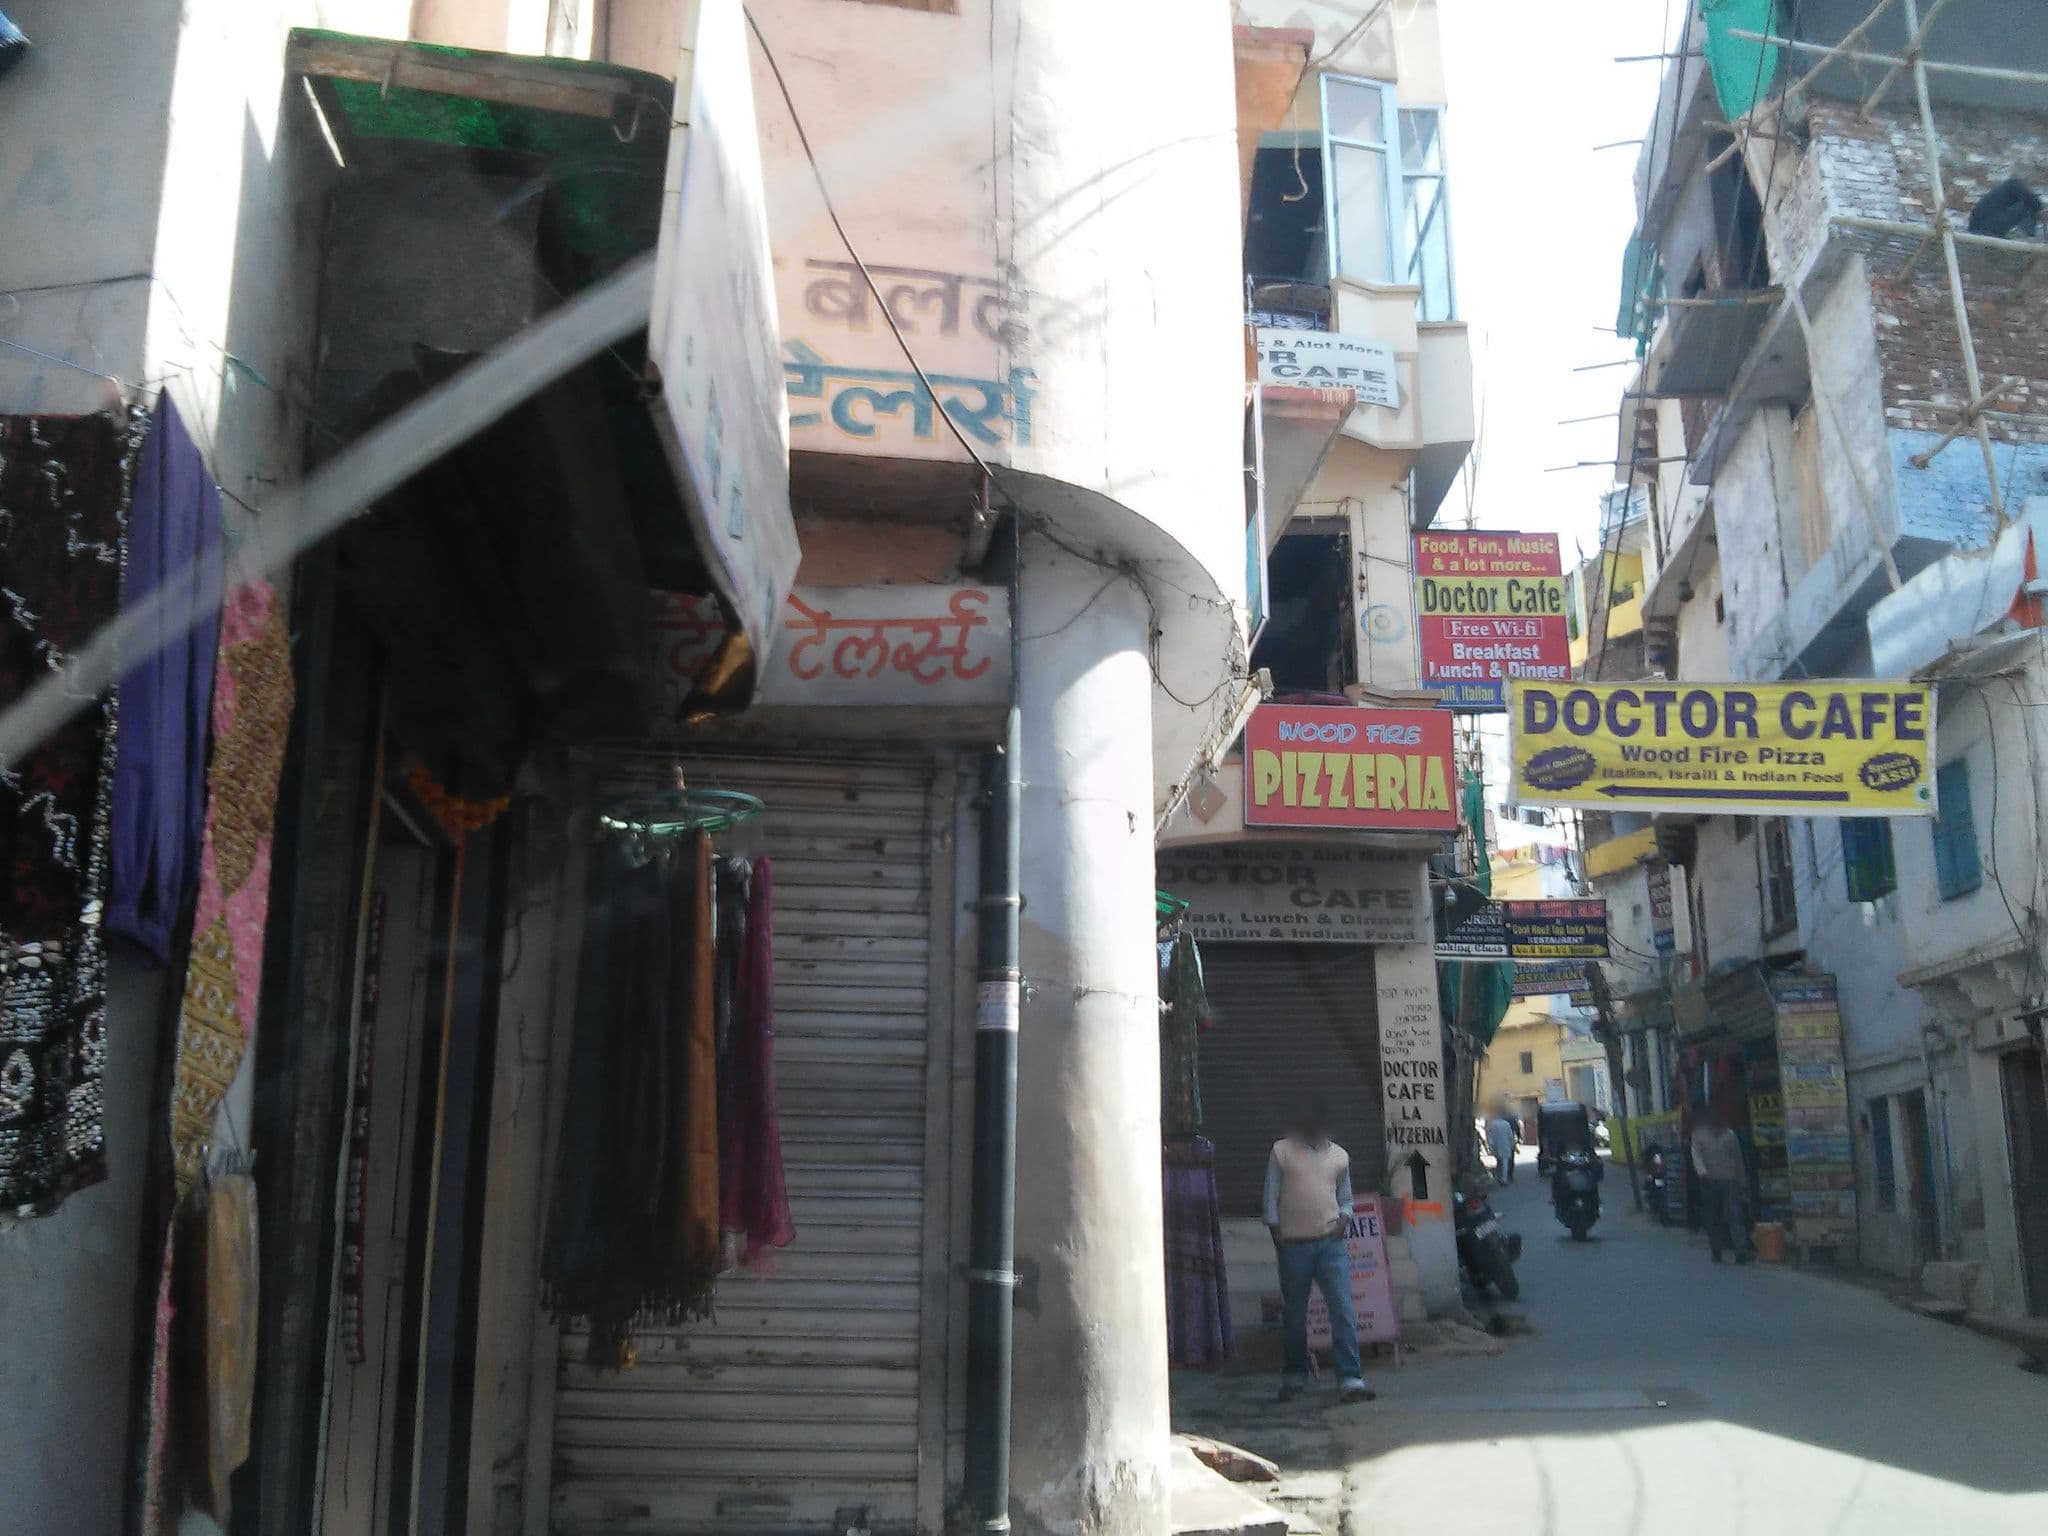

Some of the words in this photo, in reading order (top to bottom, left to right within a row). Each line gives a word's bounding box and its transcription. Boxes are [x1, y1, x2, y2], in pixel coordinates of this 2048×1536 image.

[1340, 343, 1383, 355] More
[1271, 364, 1387, 384] CAFE
[1420, 537, 1463, 556] Food,
[1468, 537, 1503, 557] Fun,
[1508, 538, 1553, 554] Music
[1433, 558, 1443, 571] &
[1450, 561, 1460, 571] a
[1464, 558, 1484, 571] lot
[1423, 579, 1498, 612] Doctor
[1507, 579, 1560, 613] Cafe
[1451, 621, 1490, 636] Free
[1493, 621, 1537, 636] Wi-fi
[1453, 643, 1540, 660] Breakfast
[1429, 662, 1483, 678] Lunch
[1489, 663, 1502, 678] &
[1508, 662, 1566, 678] Dinner
[1463, 685, 1494, 701] Italian
[1522, 690, 1759, 738] DOCTOR
[1780, 693, 1925, 741] CAFE
[1279, 721, 1357, 743] WOOD
[1621, 745, 1689, 763] Wood
[1700, 746, 1748, 764] Fire
[1760, 748, 1825, 766] Pizza
[1253, 750, 1450, 811] PIZZERIA
[1602, 767, 1662, 781] Italian,
[1725, 770, 1737, 781] &
[1743, 770, 1796, 783] Indian
[1803, 771, 1843, 784] Food
[1157, 864, 1316, 885] OCTOR
[1289, 888, 1414, 909] CAFE
[1240, 912, 1308, 925] Lunch
[1317, 913, 1332, 925] &
[1341, 913, 1415, 926] Dinner
[1269, 927, 1284, 939] &
[1292, 927, 1359, 940] Indian
[1365, 929, 1415, 941] Food
[1384, 1060, 1438, 1078] DOCTOR
[1387, 1083, 1434, 1100] CAFE
[1402, 1106, 1421, 1120] LA
[1387, 1126, 1444, 1145] PIZZERIA
